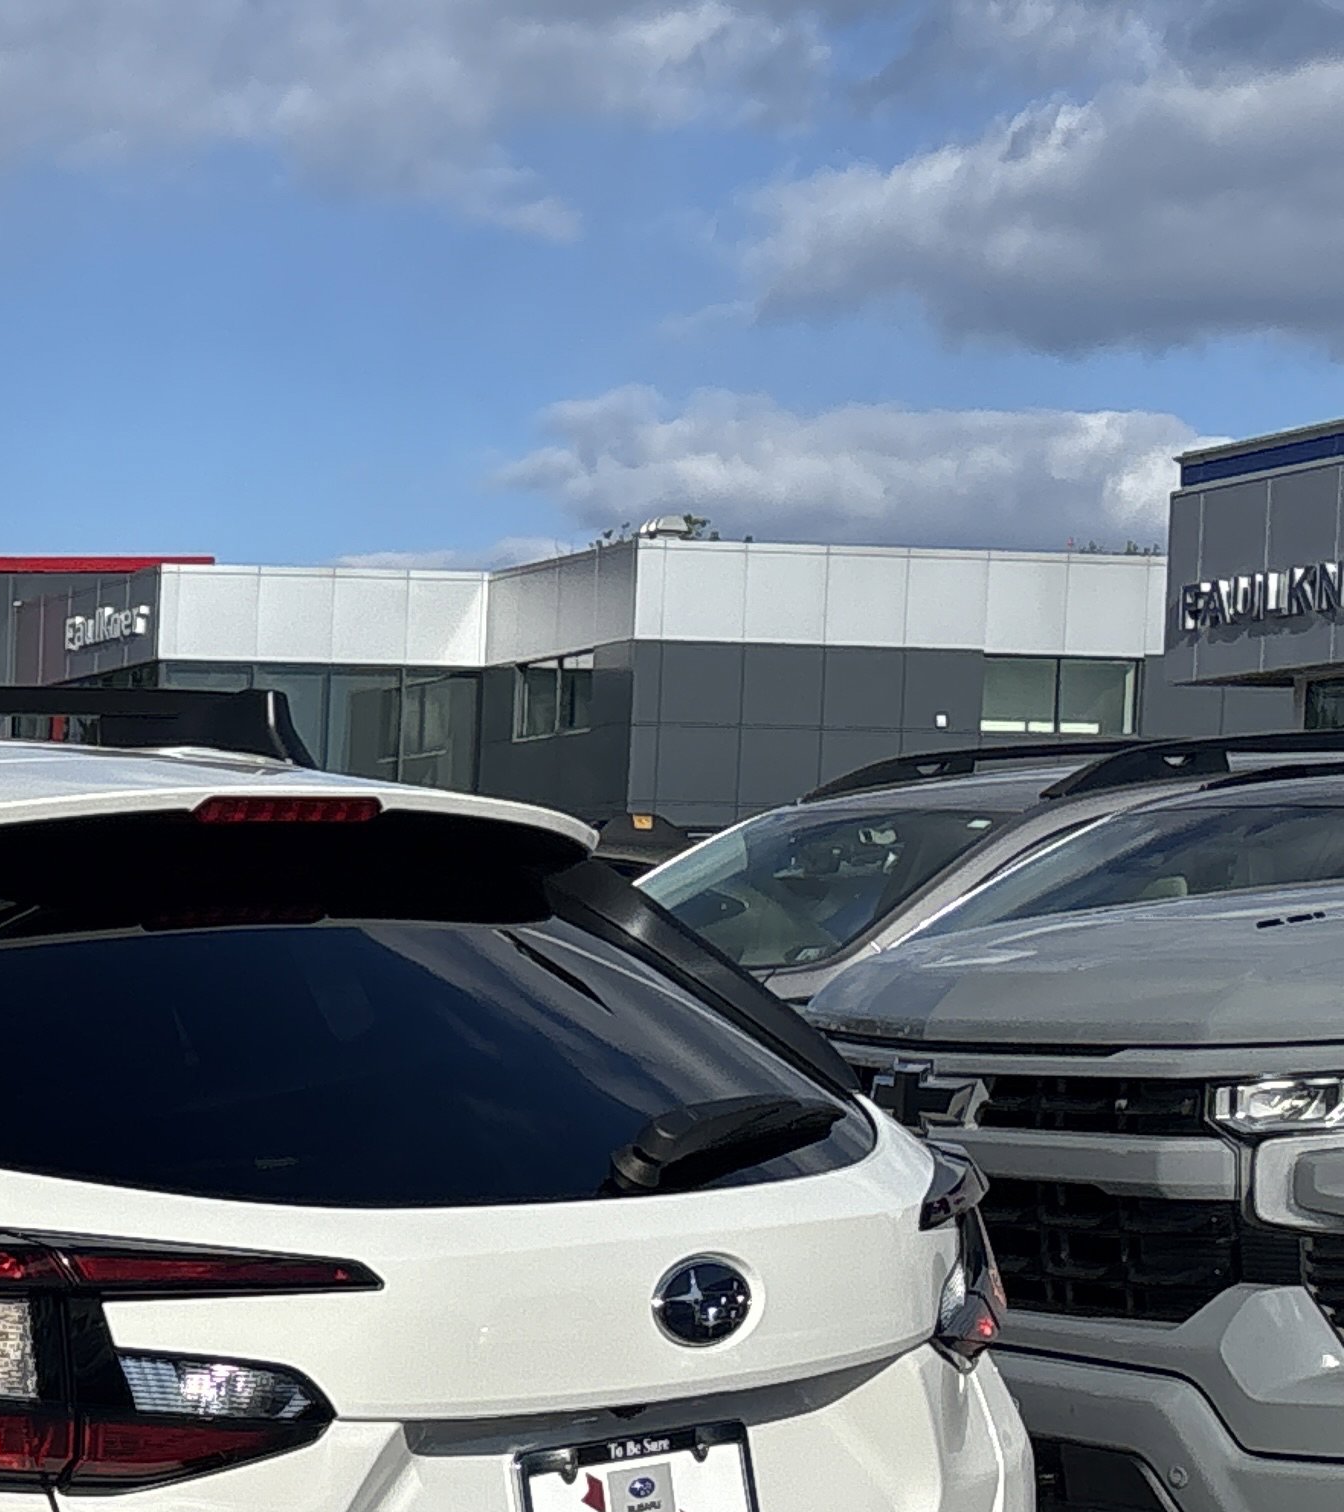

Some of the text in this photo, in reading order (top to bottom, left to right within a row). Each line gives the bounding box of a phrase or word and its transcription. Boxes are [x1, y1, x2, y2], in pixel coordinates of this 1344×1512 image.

[64, 604, 150, 652] Faulkner
[607, 1438, 670, 1459] To Be Sure
